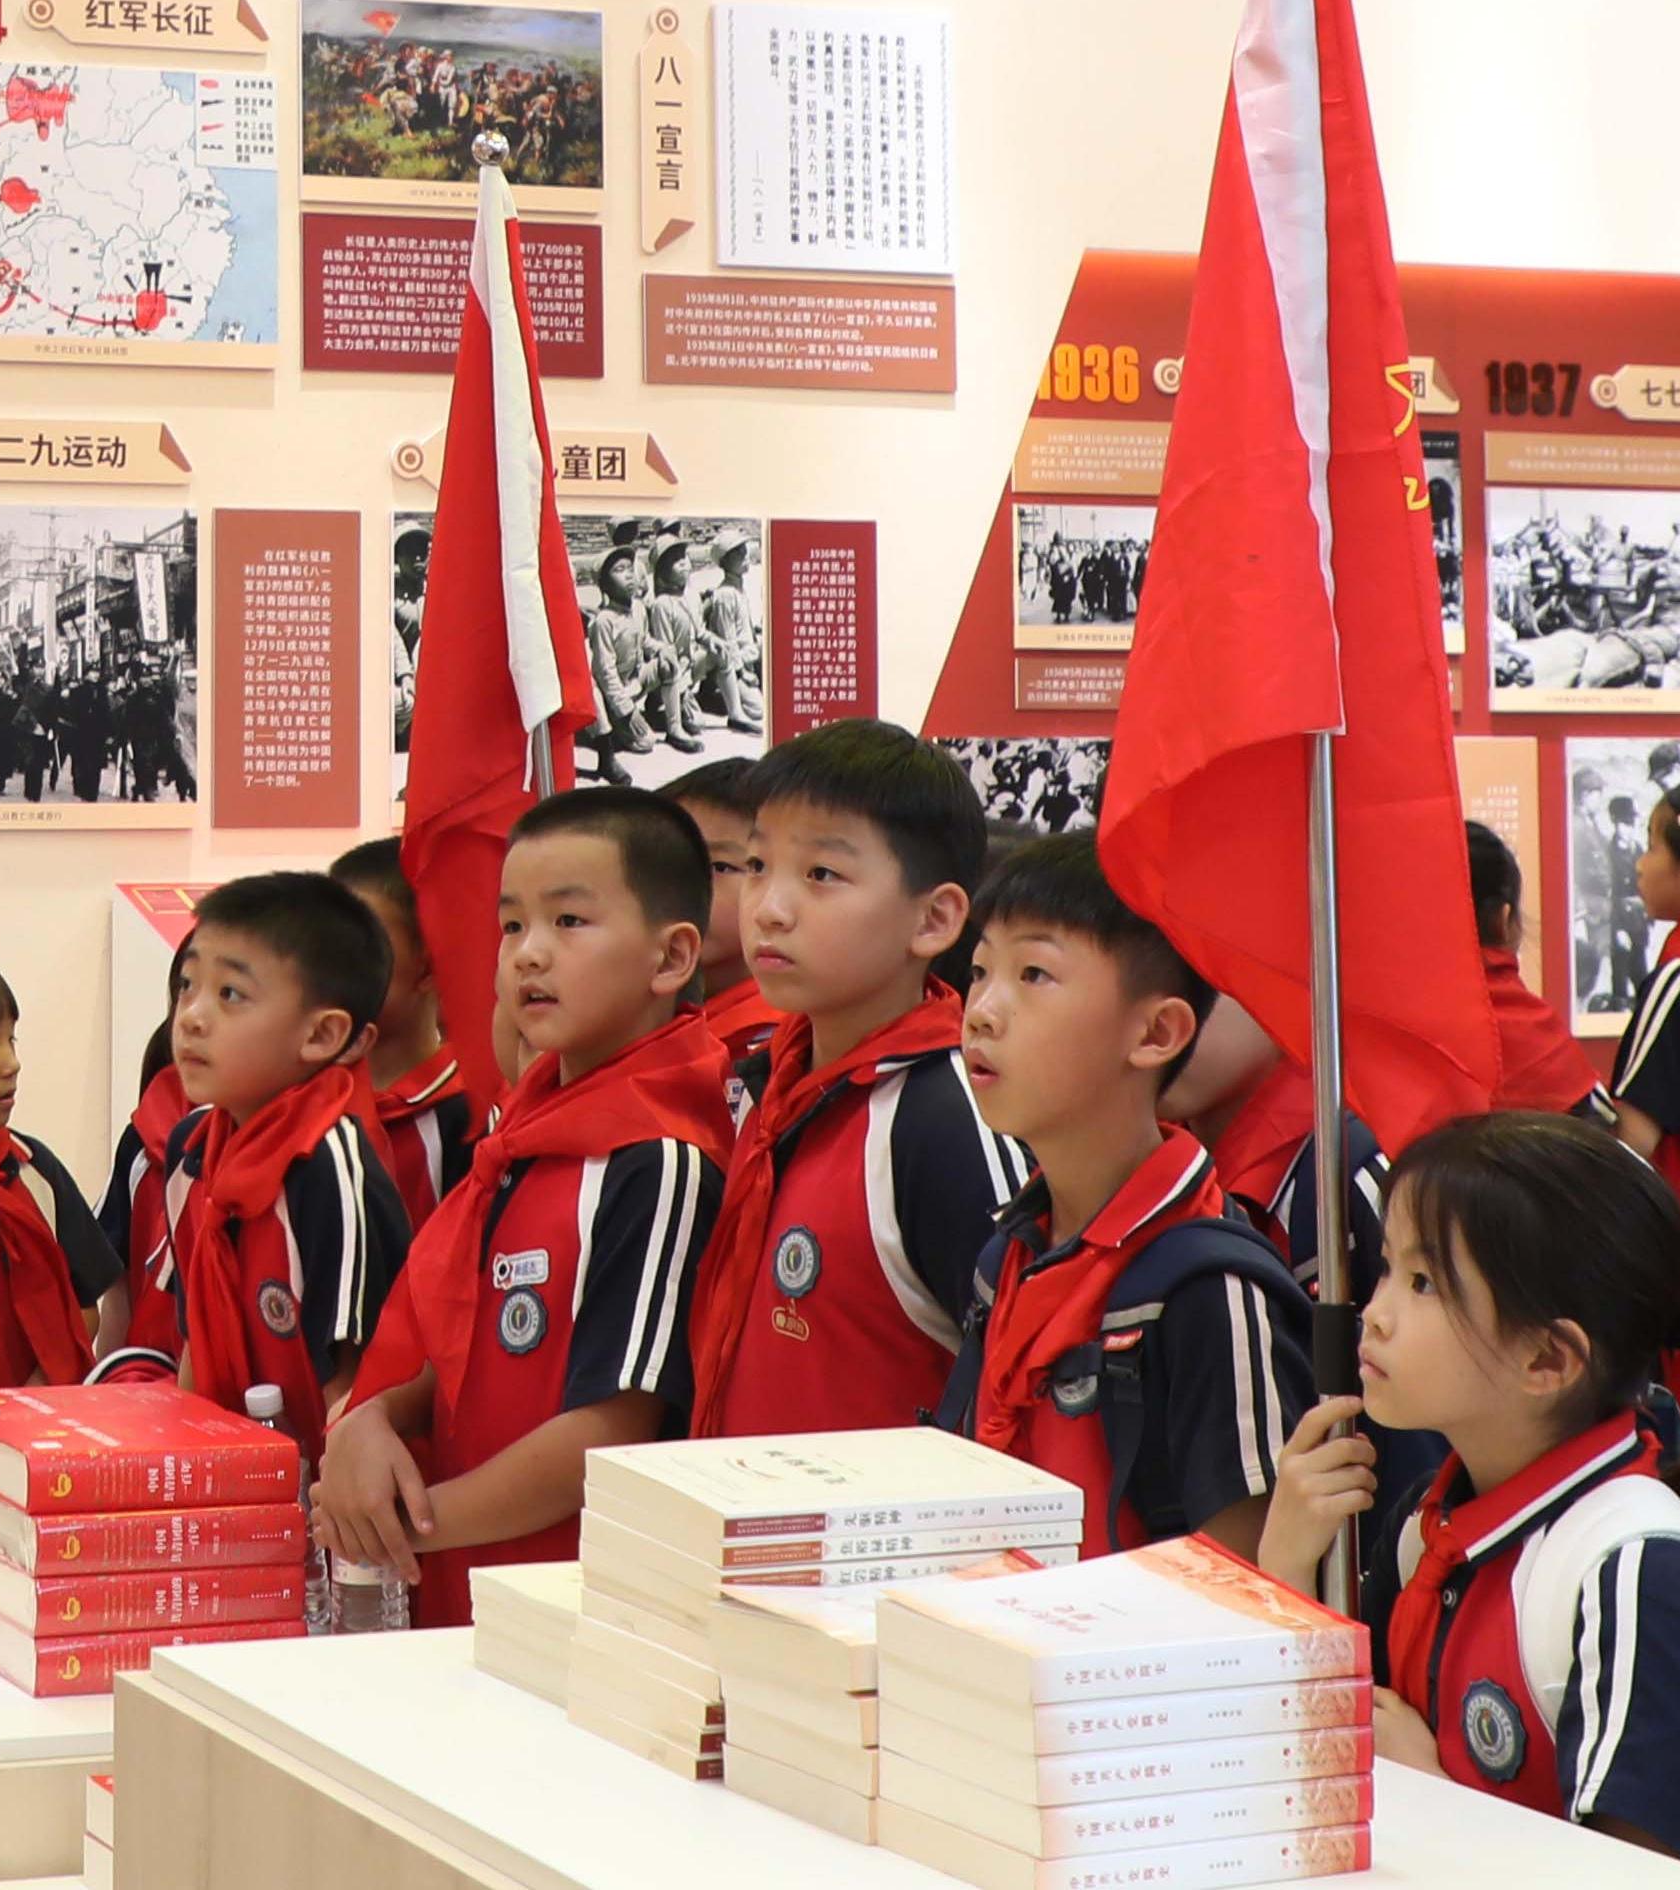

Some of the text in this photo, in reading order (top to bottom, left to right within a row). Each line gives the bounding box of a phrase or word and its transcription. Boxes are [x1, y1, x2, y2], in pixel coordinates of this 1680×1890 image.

[654, 57, 683, 191] 八一宣言
[345, 235, 472, 252] 长征是人类历史上的伟大奇
[323, 309, 463, 325] 到达陕北革命根据地,与陕北红
[529, 301, 584, 314] 1935年10月
[1037, 343, 1140, 403] 1936
[1485, 361, 1581, 418] 1937
